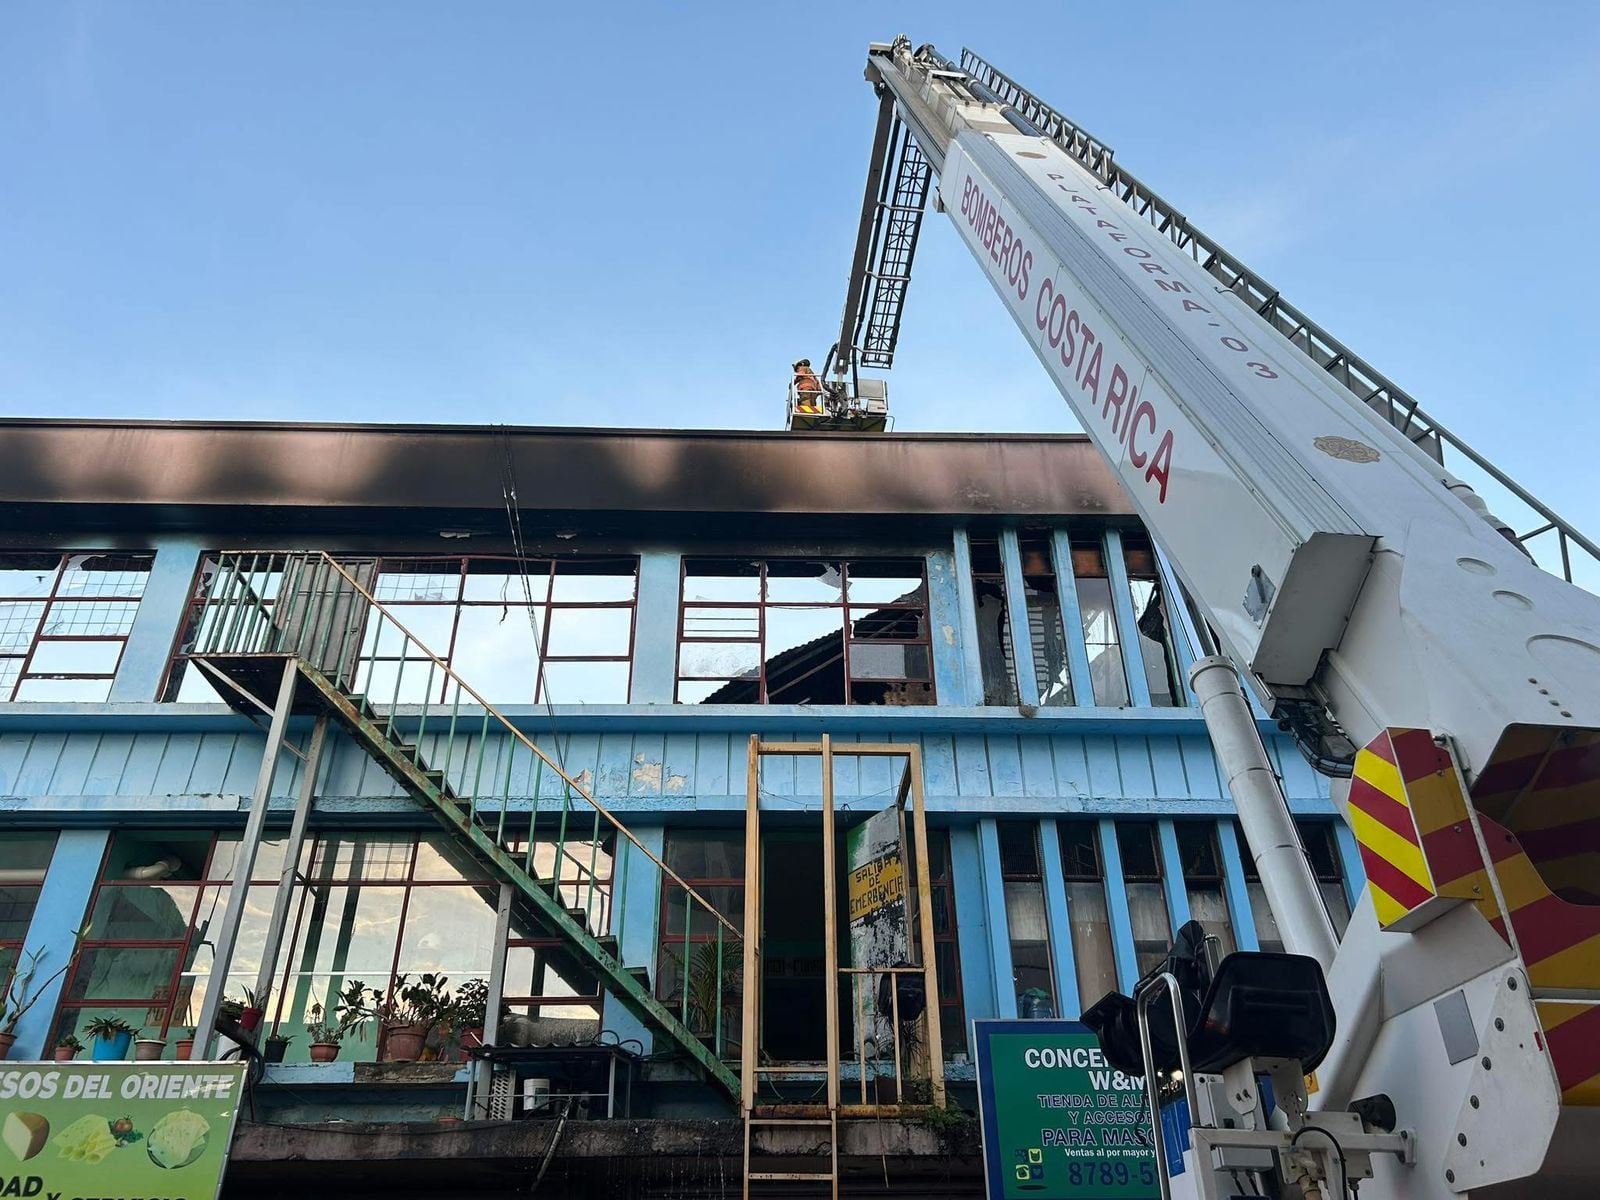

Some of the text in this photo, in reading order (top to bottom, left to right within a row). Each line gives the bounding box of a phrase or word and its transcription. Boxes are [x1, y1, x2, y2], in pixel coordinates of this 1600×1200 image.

[961, 175, 1174, 503] BOMBEROS COSTA RICA
[869, 873, 880, 888] DE
[1024, 1048, 1109, 1068] CONCE
[62, 1075, 113, 1099] DEL
[120, 1075, 234, 1099] ORIENTE
[1037, 1094, 1094, 1108] TIENDA
[1097, 1094, 1118, 1107] DE
[1068, 1110, 1079, 1124] Y
[1042, 1128, 1097, 1146] PARA
[1065, 1148, 1156, 1158] Ventas al por mayor y
